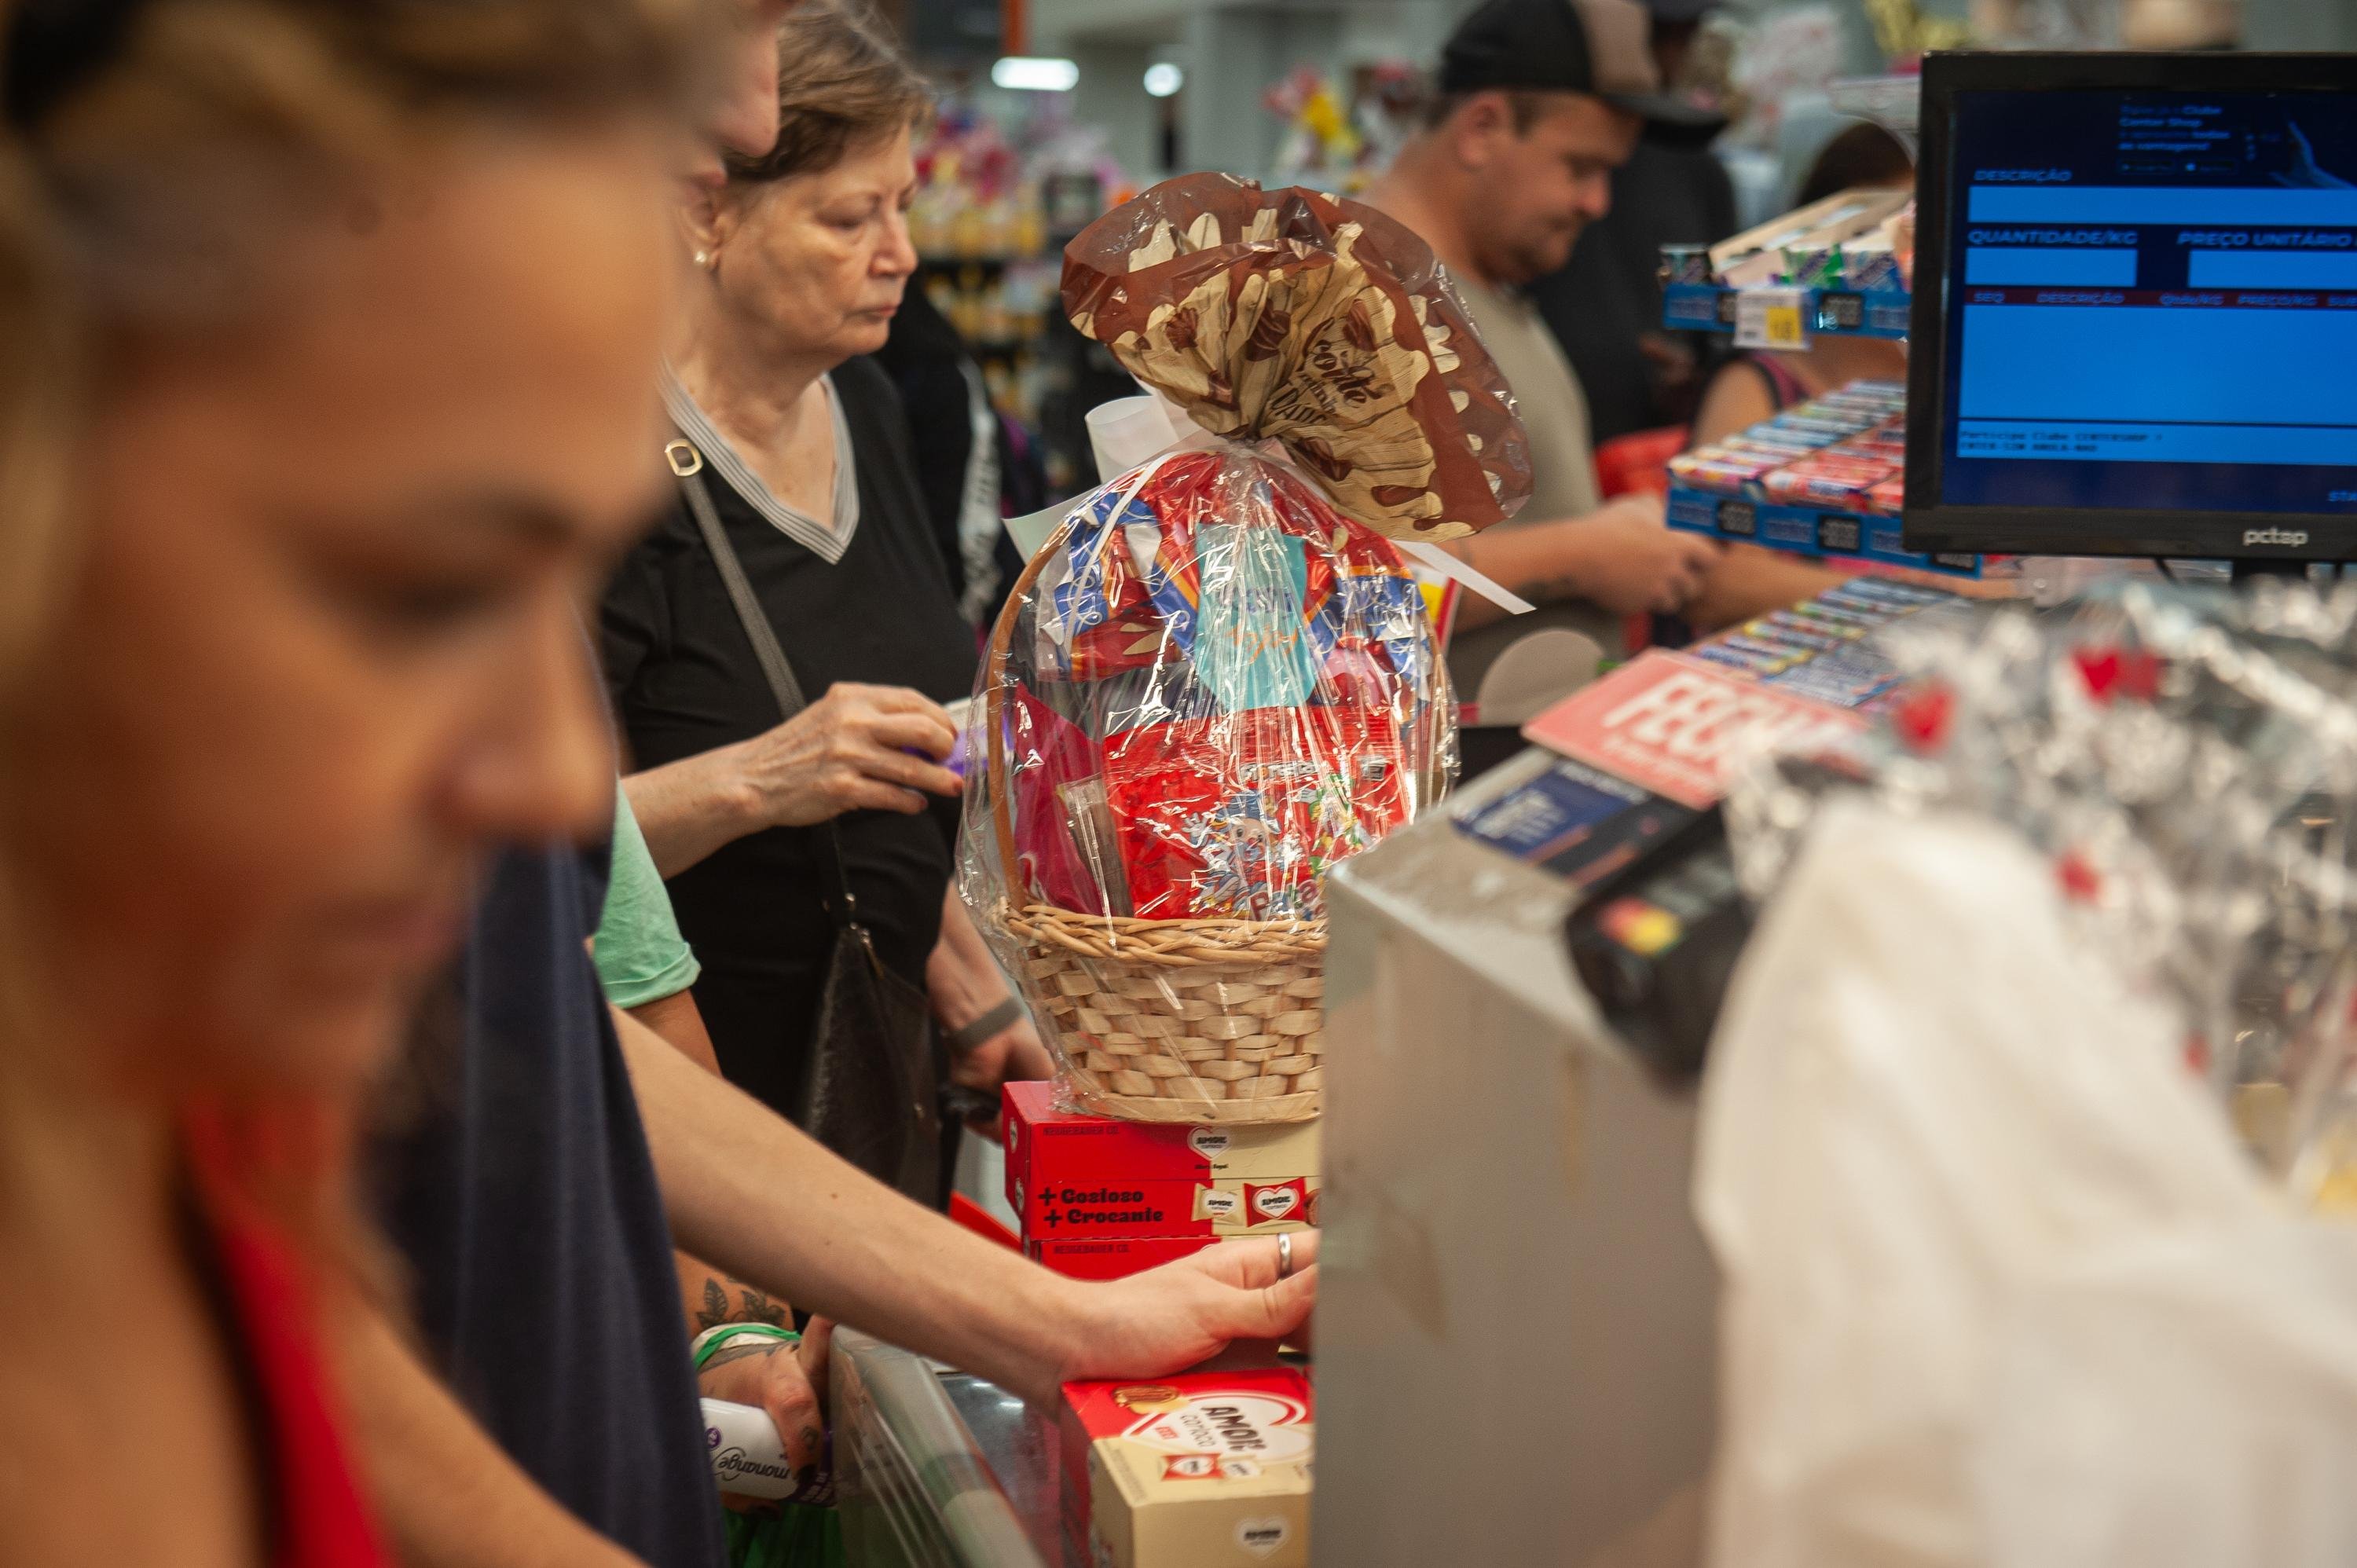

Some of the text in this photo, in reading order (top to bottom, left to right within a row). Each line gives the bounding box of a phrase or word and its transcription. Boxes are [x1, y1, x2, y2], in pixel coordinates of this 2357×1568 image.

[2182, 105, 2223, 115] Clube
[2119, 117, 2202, 128] Center Shop
[1973, 168, 2073, 184] DESCRIÇÃO
[1967, 229, 2139, 246] QUANTIDADE/KG
[2176, 230, 2352, 249] PREÇO UNITÁRIO
[2036, 290, 2126, 306] DESCRIÇÃO
[1067, 1207, 1164, 1224] Crocante
[1199, 1405, 1267, 1453] AMOR
[717, 1453, 791, 1480] monange
